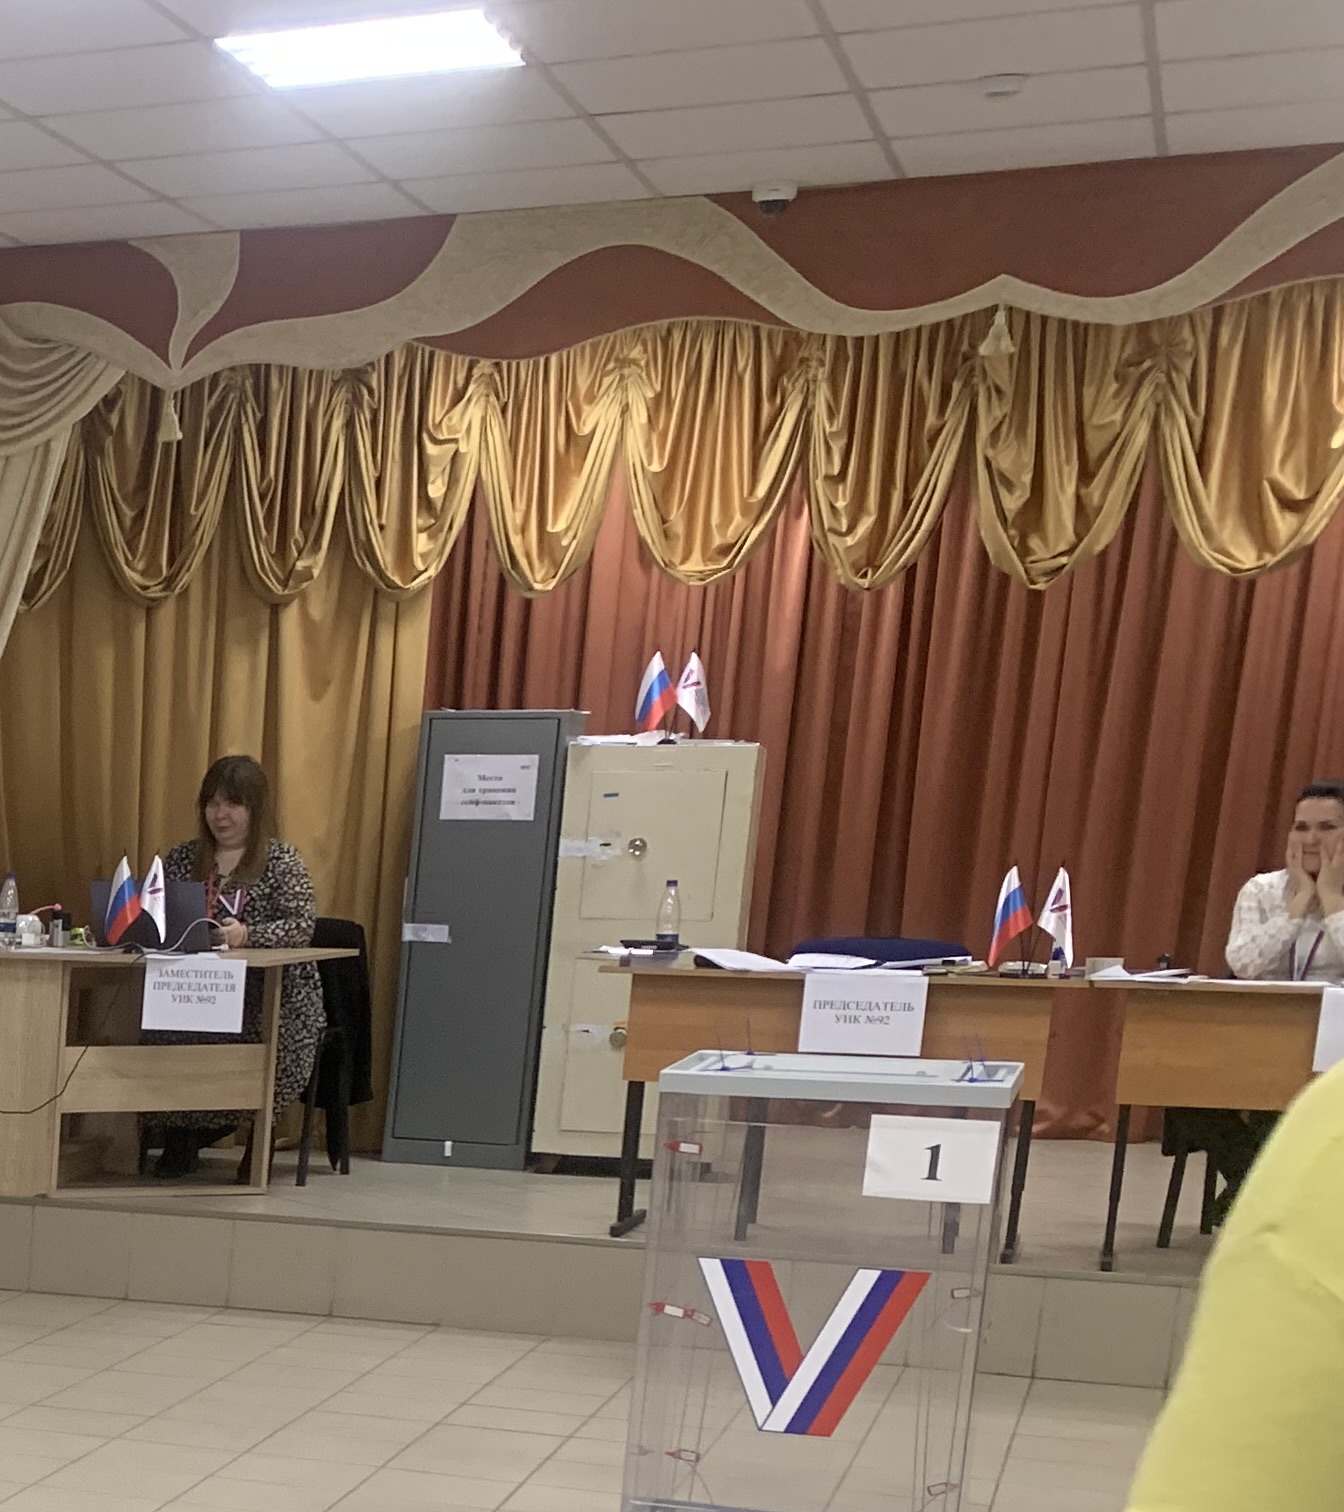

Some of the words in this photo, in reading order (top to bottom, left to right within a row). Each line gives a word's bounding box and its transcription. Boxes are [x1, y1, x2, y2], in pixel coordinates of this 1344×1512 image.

[159, 968, 234, 980] ЗАМЕСТИТЕЛЬ
[153, 981, 236, 993] ПРЕДСЕДАТЕЛЯ
[171, 994, 193, 1004] УИК
[813, 999, 915, 1012] ПРЕДСЕДАТЕЛЬ
[835, 1014, 861, 1024] УИК
[921, 1144, 942, 1181] 1
[698, 1257, 932, 1437] V
